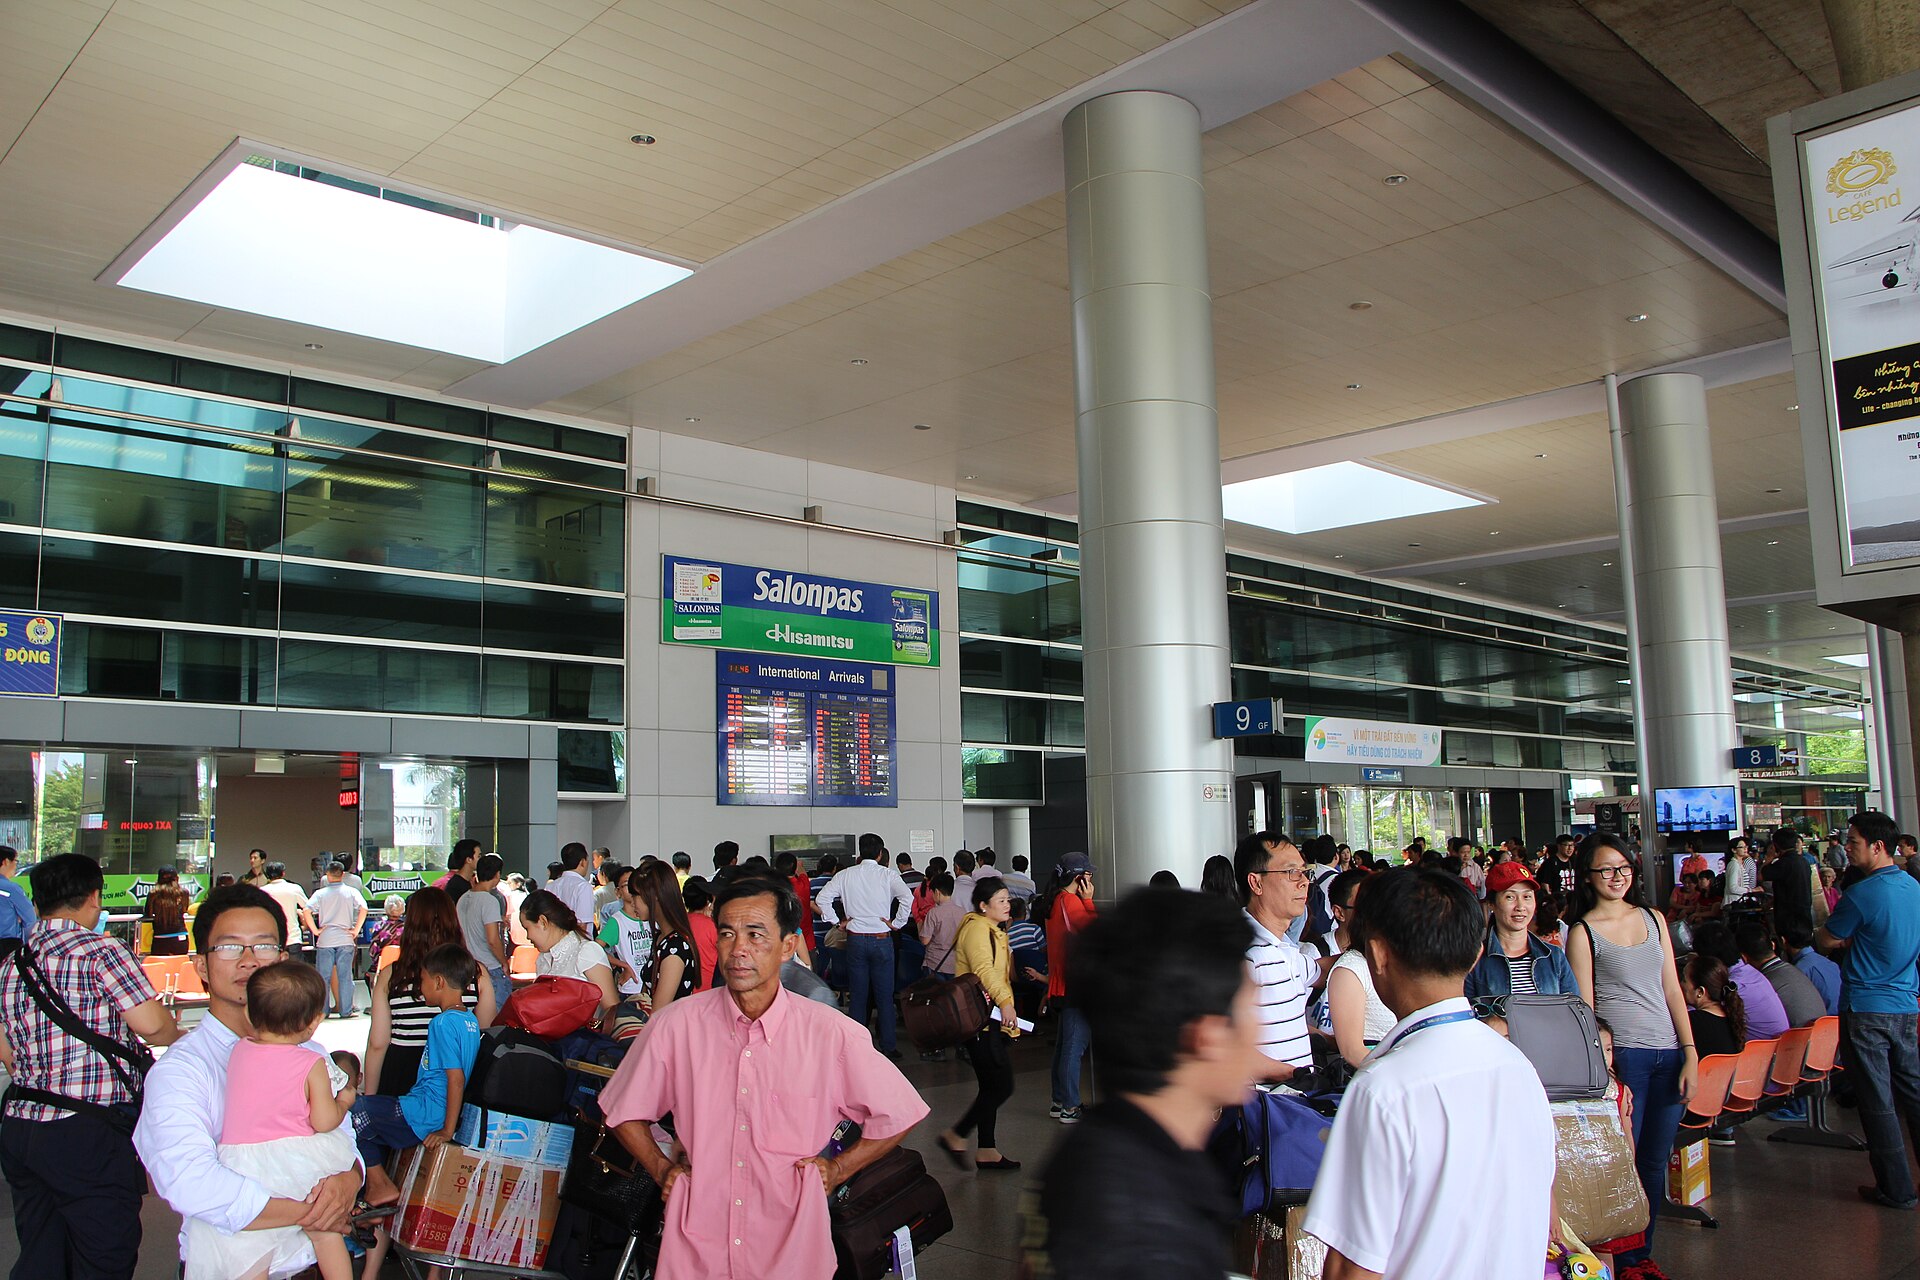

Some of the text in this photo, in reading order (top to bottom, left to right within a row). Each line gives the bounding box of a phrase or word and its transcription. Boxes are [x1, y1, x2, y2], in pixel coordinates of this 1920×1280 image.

[1827, 187, 1902, 224] Legend
[1874, 361, 1911, 378] Những
[1853, 385, 1877, 399] bên
[1861, 405, 1875, 414] Life
[1881, 397, 1913, 410] changing
[753, 570, 863, 615] Salonpas
[678, 604, 720, 613] SALONPAS
[765, 623, 854, 650] Hisamitsu
[894, 622, 925, 635] Salonpas
[5, 647, 51, 665] ĐỘNG
[758, 664, 865, 684] International Arrivals
[1235, 705, 1270, 731] 9 GF
[1750, 749, 1761, 765] 8
[339, 792, 352, 806] CARD
[371, 879, 421, 891] DOUBLEMINT
